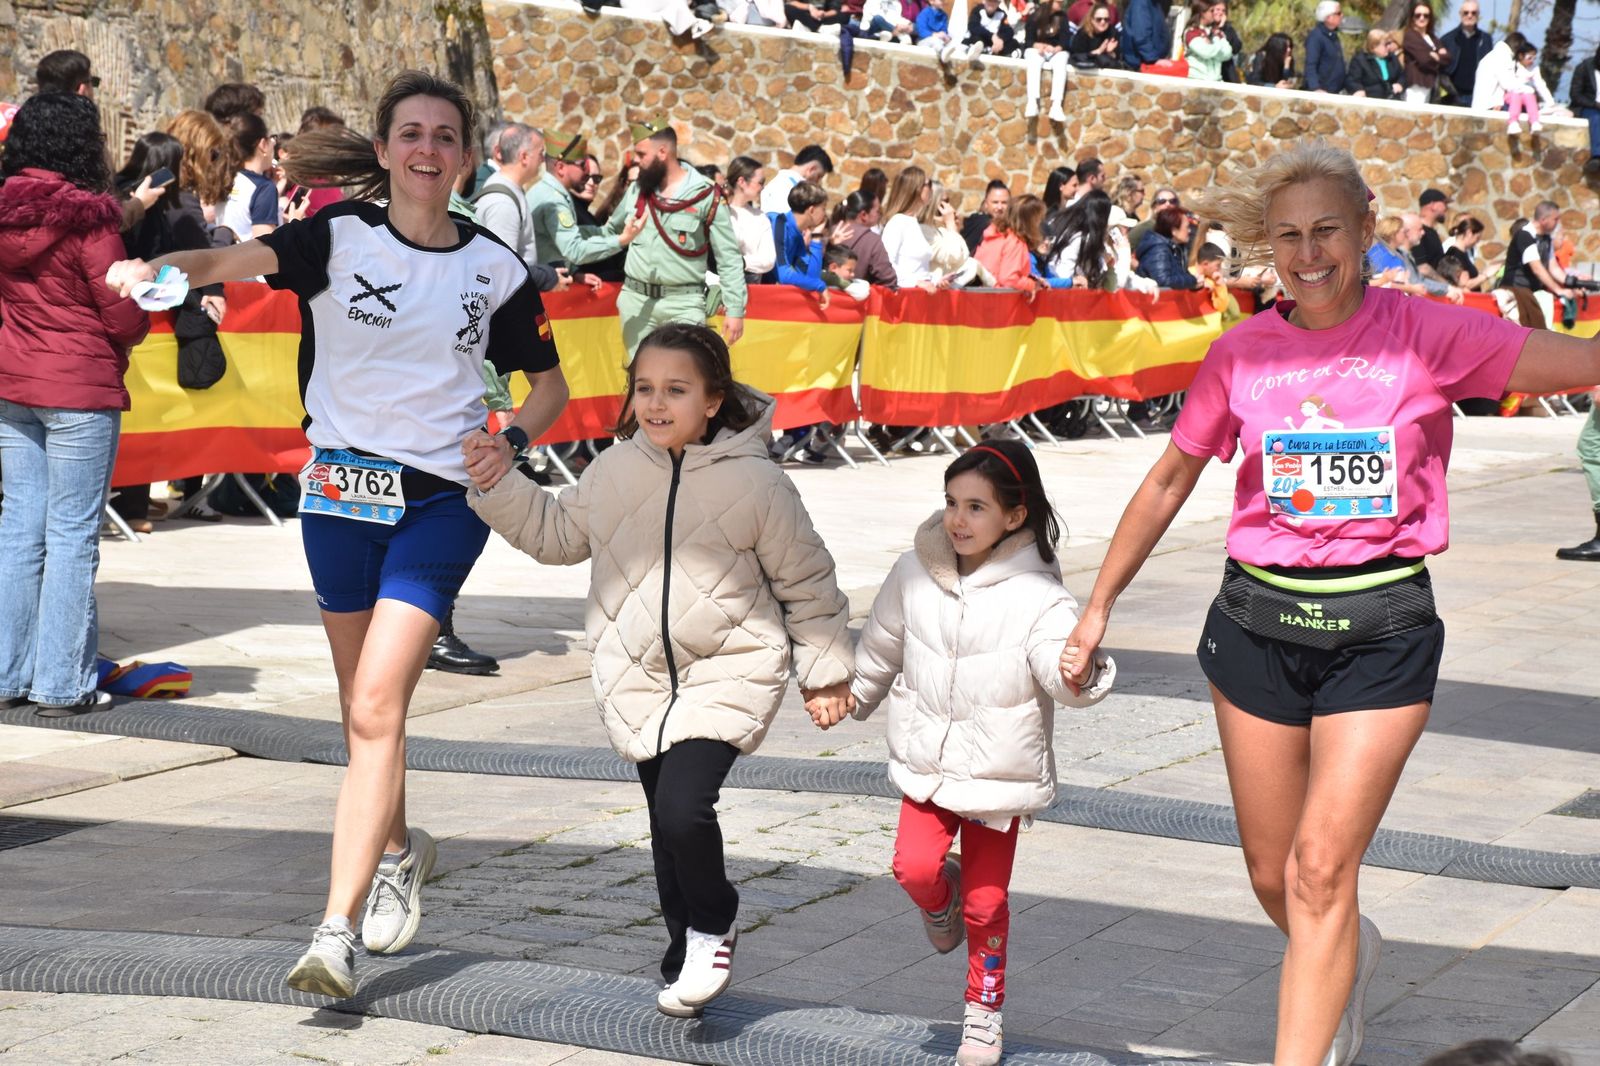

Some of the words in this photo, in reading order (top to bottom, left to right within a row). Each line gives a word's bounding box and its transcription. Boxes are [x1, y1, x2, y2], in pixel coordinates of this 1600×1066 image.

[460, 292, 469, 301] LA
[347, 306, 392, 329] EDICIÓN
[1251, 368, 1311, 401] Corre
[1313, 365, 1333, 378] en
[1336, 356, 1398, 387] Risa
[1310, 454, 1385, 485] 1569
[308, 480, 323, 493] 20
[335, 466, 397, 497] 3762
[1279, 613, 1351, 631] HANKER
